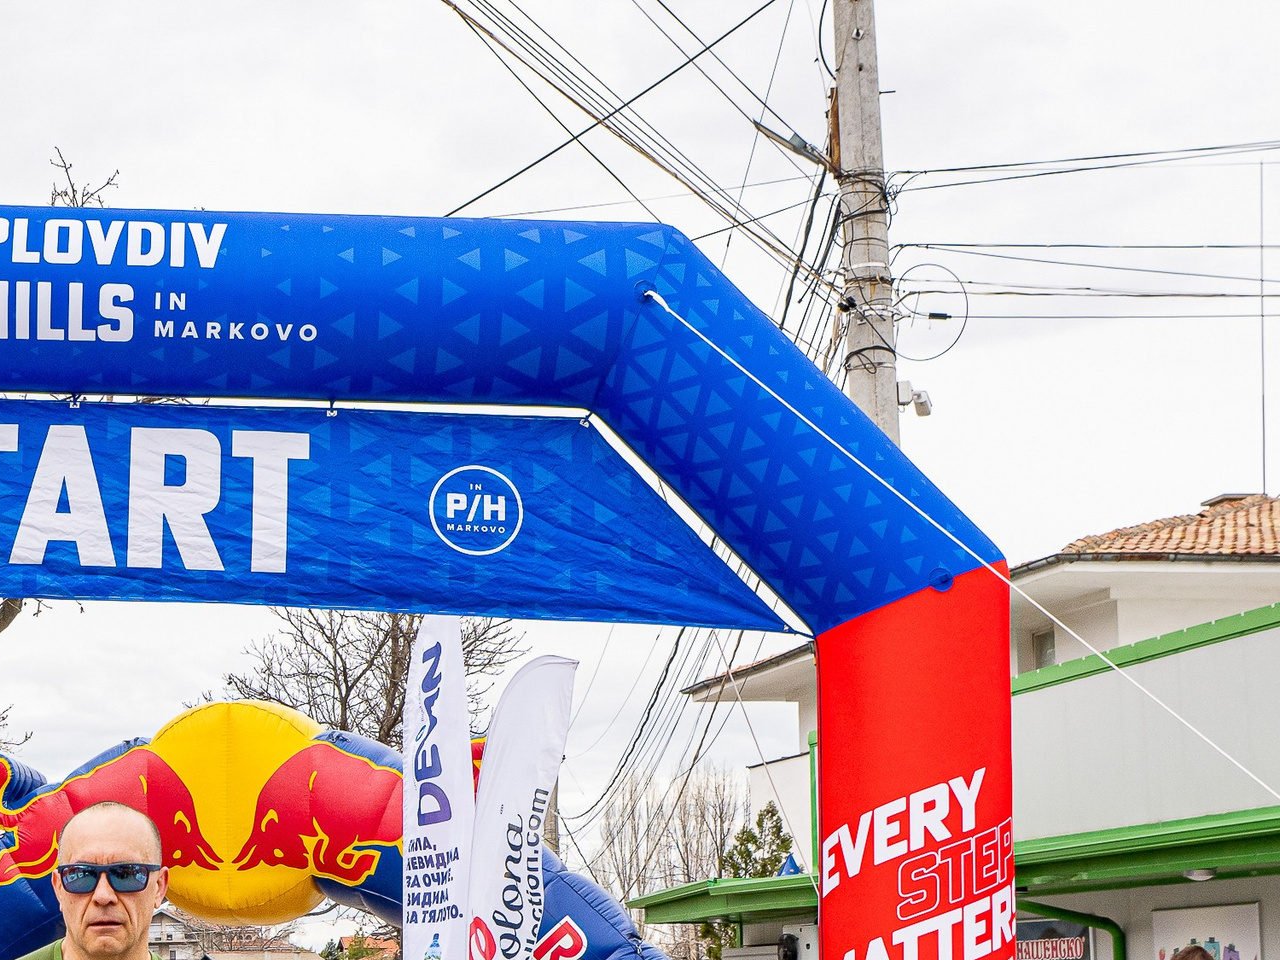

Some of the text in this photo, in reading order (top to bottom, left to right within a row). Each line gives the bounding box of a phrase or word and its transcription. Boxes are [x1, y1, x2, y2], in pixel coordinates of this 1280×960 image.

[155, 292, 187, 311] IN
[154, 320, 318, 342] MARKOVO
[470, 483, 482, 491] IN
[446, 493, 506, 522] P/H
[446, 524, 506, 534] MARKOVO
[822, 767, 986, 898] EVERY
[897, 817, 1013, 921] STEP
